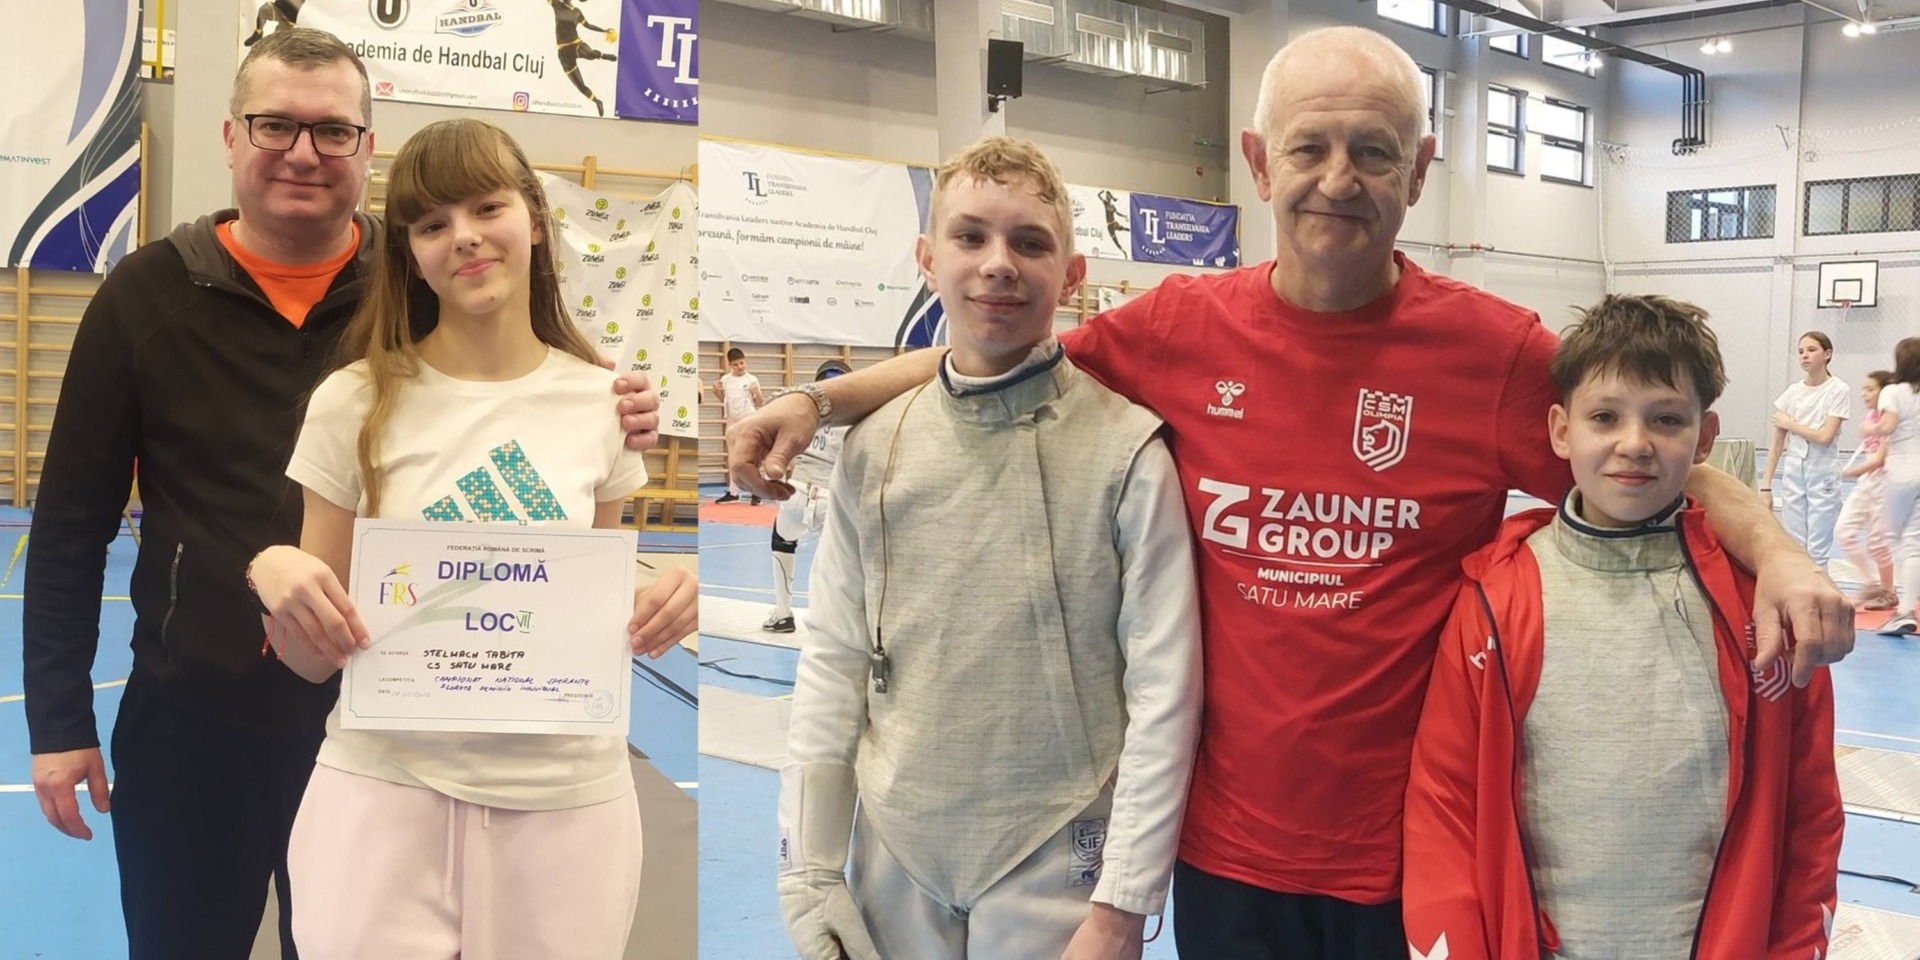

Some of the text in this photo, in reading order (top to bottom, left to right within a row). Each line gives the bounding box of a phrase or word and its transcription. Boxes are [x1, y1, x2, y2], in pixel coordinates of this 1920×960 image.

[440, 12, 502, 27] HANDBAL
[346, 39, 545, 79] ademia de Handbal Cluj
[742, 171, 767, 197] TL
[741, 215, 769, 224] Leaders
[795, 221, 826, 230] Academia
[836, 224, 864, 233] Handbal
[864, 226, 878, 236] Cluj
[1074, 226, 1089, 237] dbal
[1140, 208, 1165, 244] TL
[1166, 221, 1210, 234] TRANSILVANIA
[777, 236, 821, 249] campionii
[823, 238, 834, 249] de
[1166, 232, 1193, 242] LEADERS
[1207, 403, 1244, 419] hummel
[1363, 400, 1406, 414] CSM
[1363, 409, 1404, 421] OLIMPIA
[1260, 487, 1421, 529] ZAUNER
[1258, 523, 1393, 559] GROUP
[438, 559, 549, 583] DIPLOMĂ
[1257, 567, 1344, 586] MUNICIPIUL
[379, 582, 418, 607] FRS
[1237, 582, 1365, 609] SATU MARE
[465, 612, 515, 632] LOC
[449, 661, 476, 669] SATU
